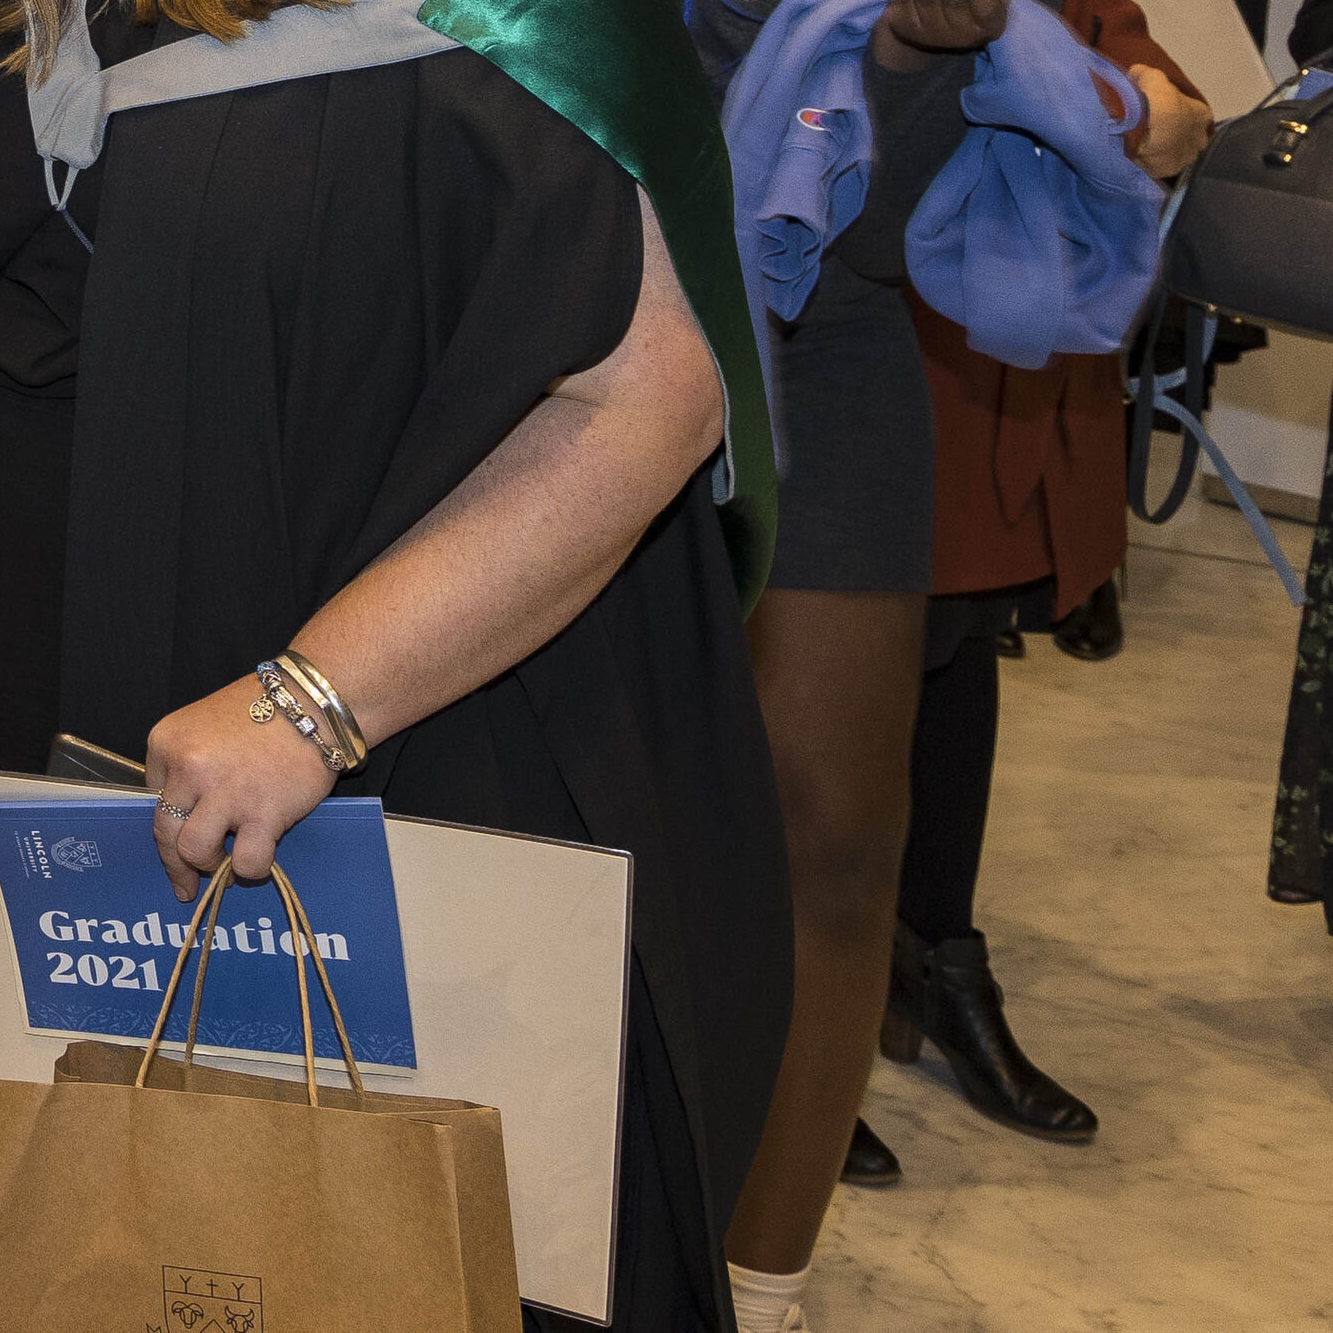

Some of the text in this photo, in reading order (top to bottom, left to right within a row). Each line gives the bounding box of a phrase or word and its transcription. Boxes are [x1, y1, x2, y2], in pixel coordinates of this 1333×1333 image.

[23, 836, 38, 873] UNIVERSITY
[31, 830, 53, 879] LINCOLN
[38, 910, 352, 961] Graduation
[46, 951, 165, 992] 2021
